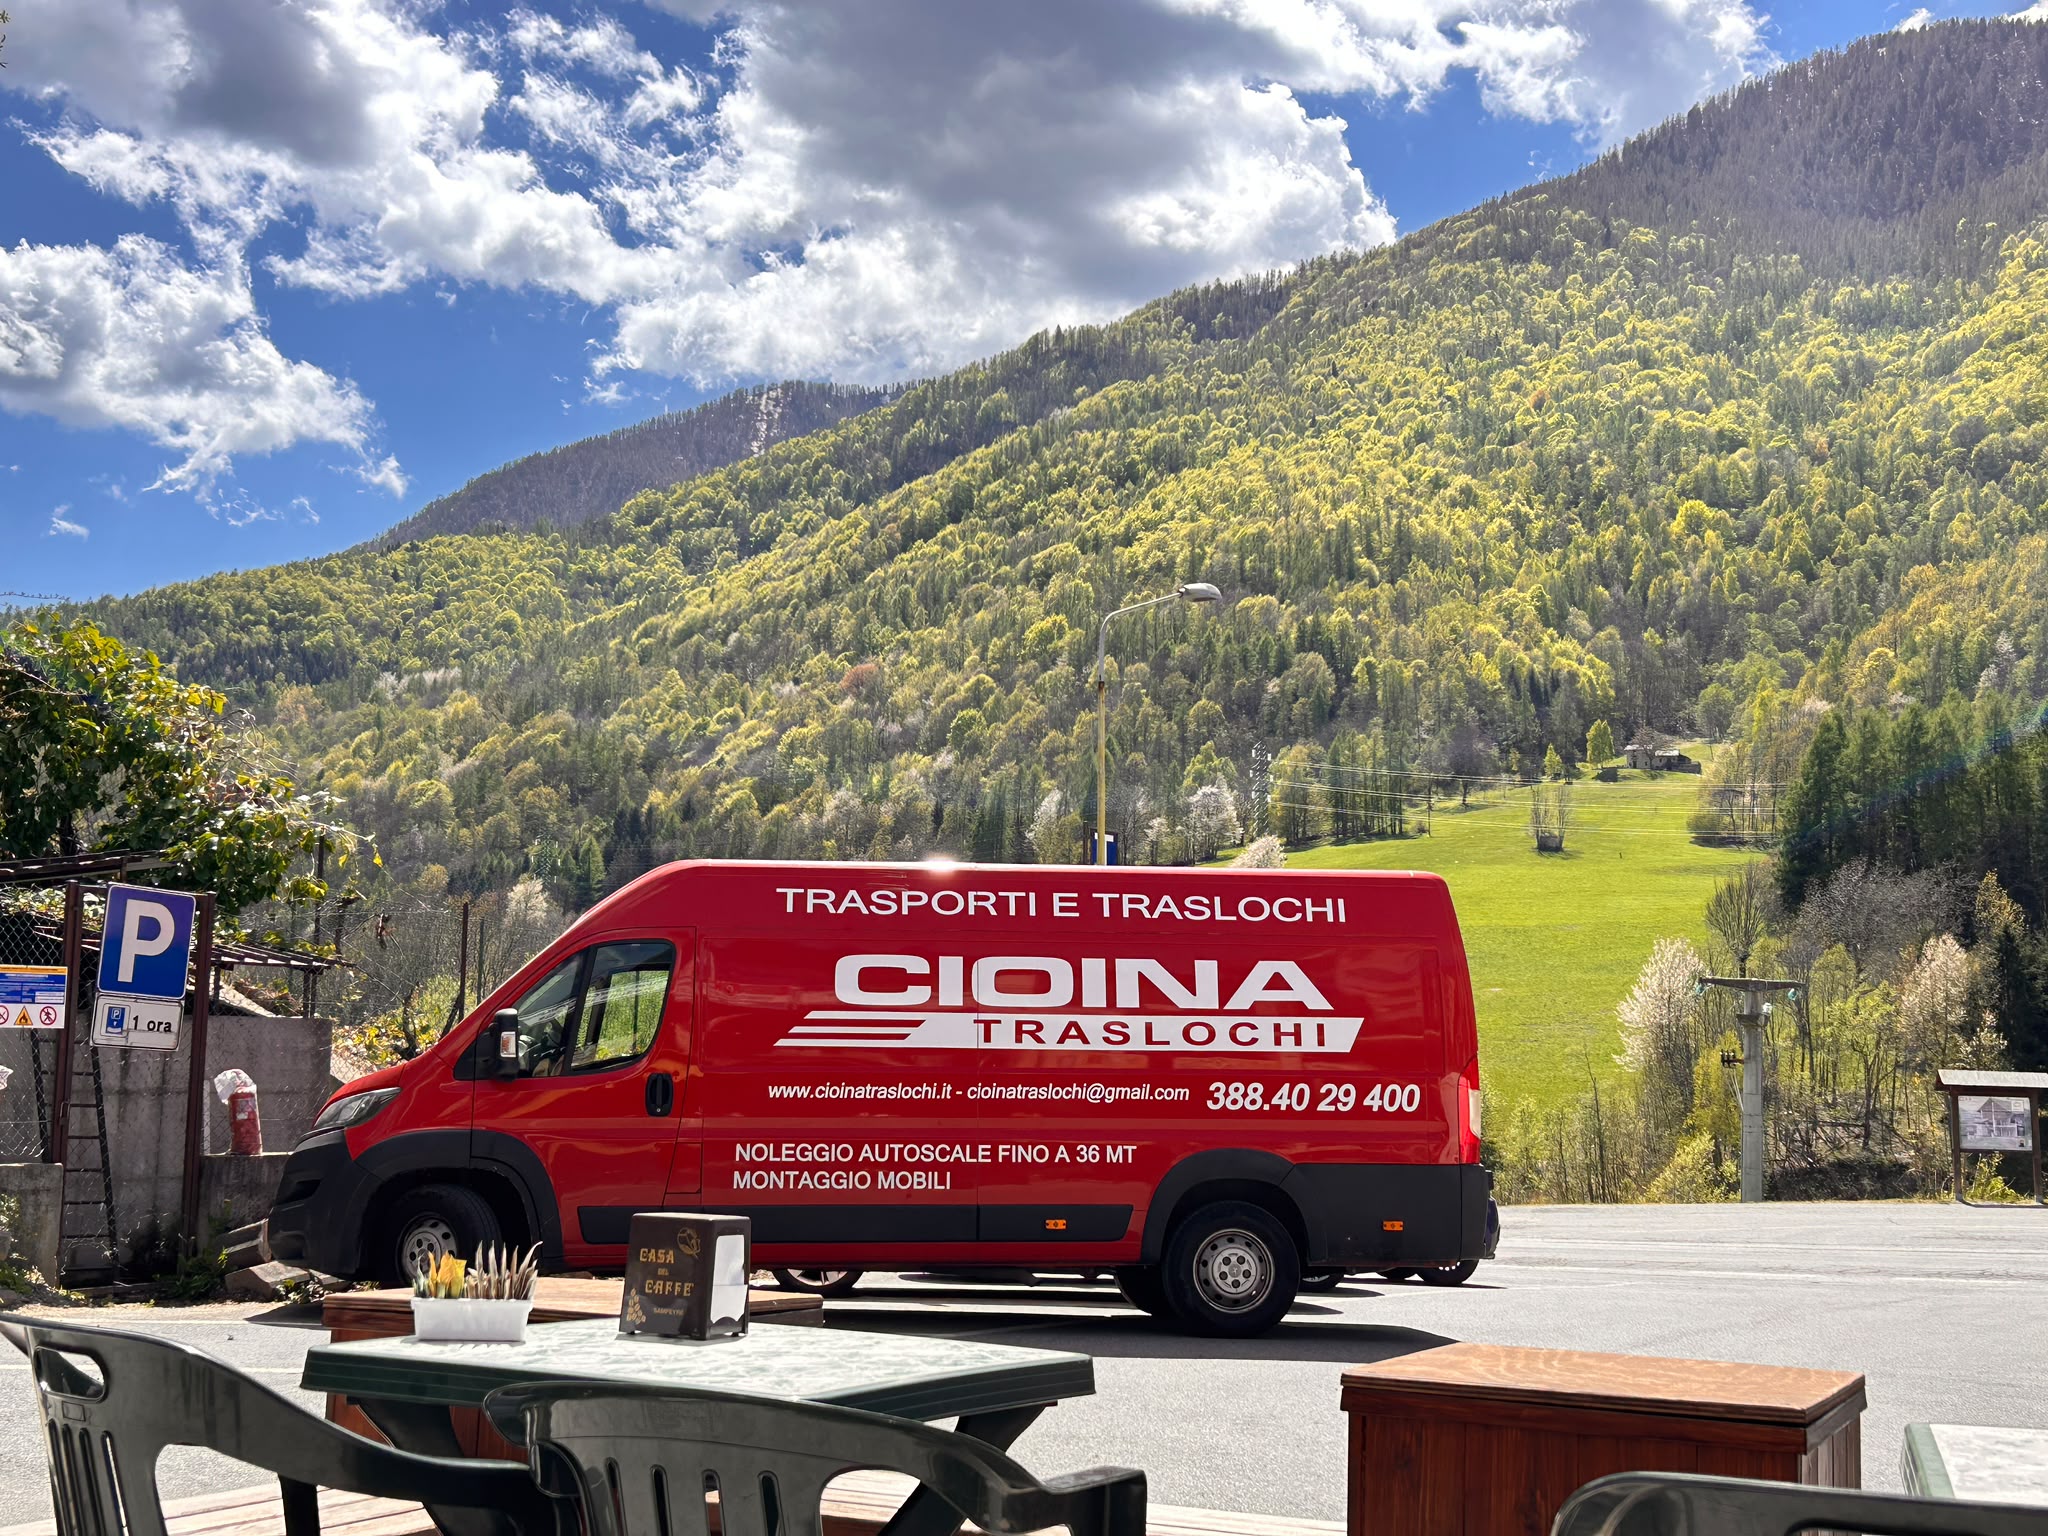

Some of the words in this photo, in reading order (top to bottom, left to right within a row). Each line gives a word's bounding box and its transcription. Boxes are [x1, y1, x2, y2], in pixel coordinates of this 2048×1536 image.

[775, 887, 1037, 917] TRASPORTI
[1052, 892, 1080, 917] E
[1092, 892, 1347, 923] TRASLOCHI
[117, 898, 175, 983] P
[834, 954, 1334, 1010] CIOINA
[133, 1015, 139, 1031] 1
[147, 1020, 172, 1032] ora
[973, 1018, 1326, 1047] TRASLOCHI
[768, 1082, 952, 1100] www.cioinatraslochi.it
[967, 1083, 1190, 1103] cioinatraslochi@gmail.com
[1206, 1082, 1310, 1111] 388.40
[1316, 1083, 1356, 1112] 29
[1363, 1084, 1421, 1112] 400
[734, 1143, 853, 1162] NOLEGGIO
[858, 1144, 992, 1163] AUTOSCALE
[998, 1145, 1050, 1163] FINO
[1053, 1144, 1071, 1163] A
[1076, 1145, 1100, 1163] 36
[1106, 1146, 1137, 1163] MT
[732, 1171, 871, 1190] MONTAGGIO
[877, 1171, 951, 1190] MOBILI
[639, 1248, 675, 1264] CASA
